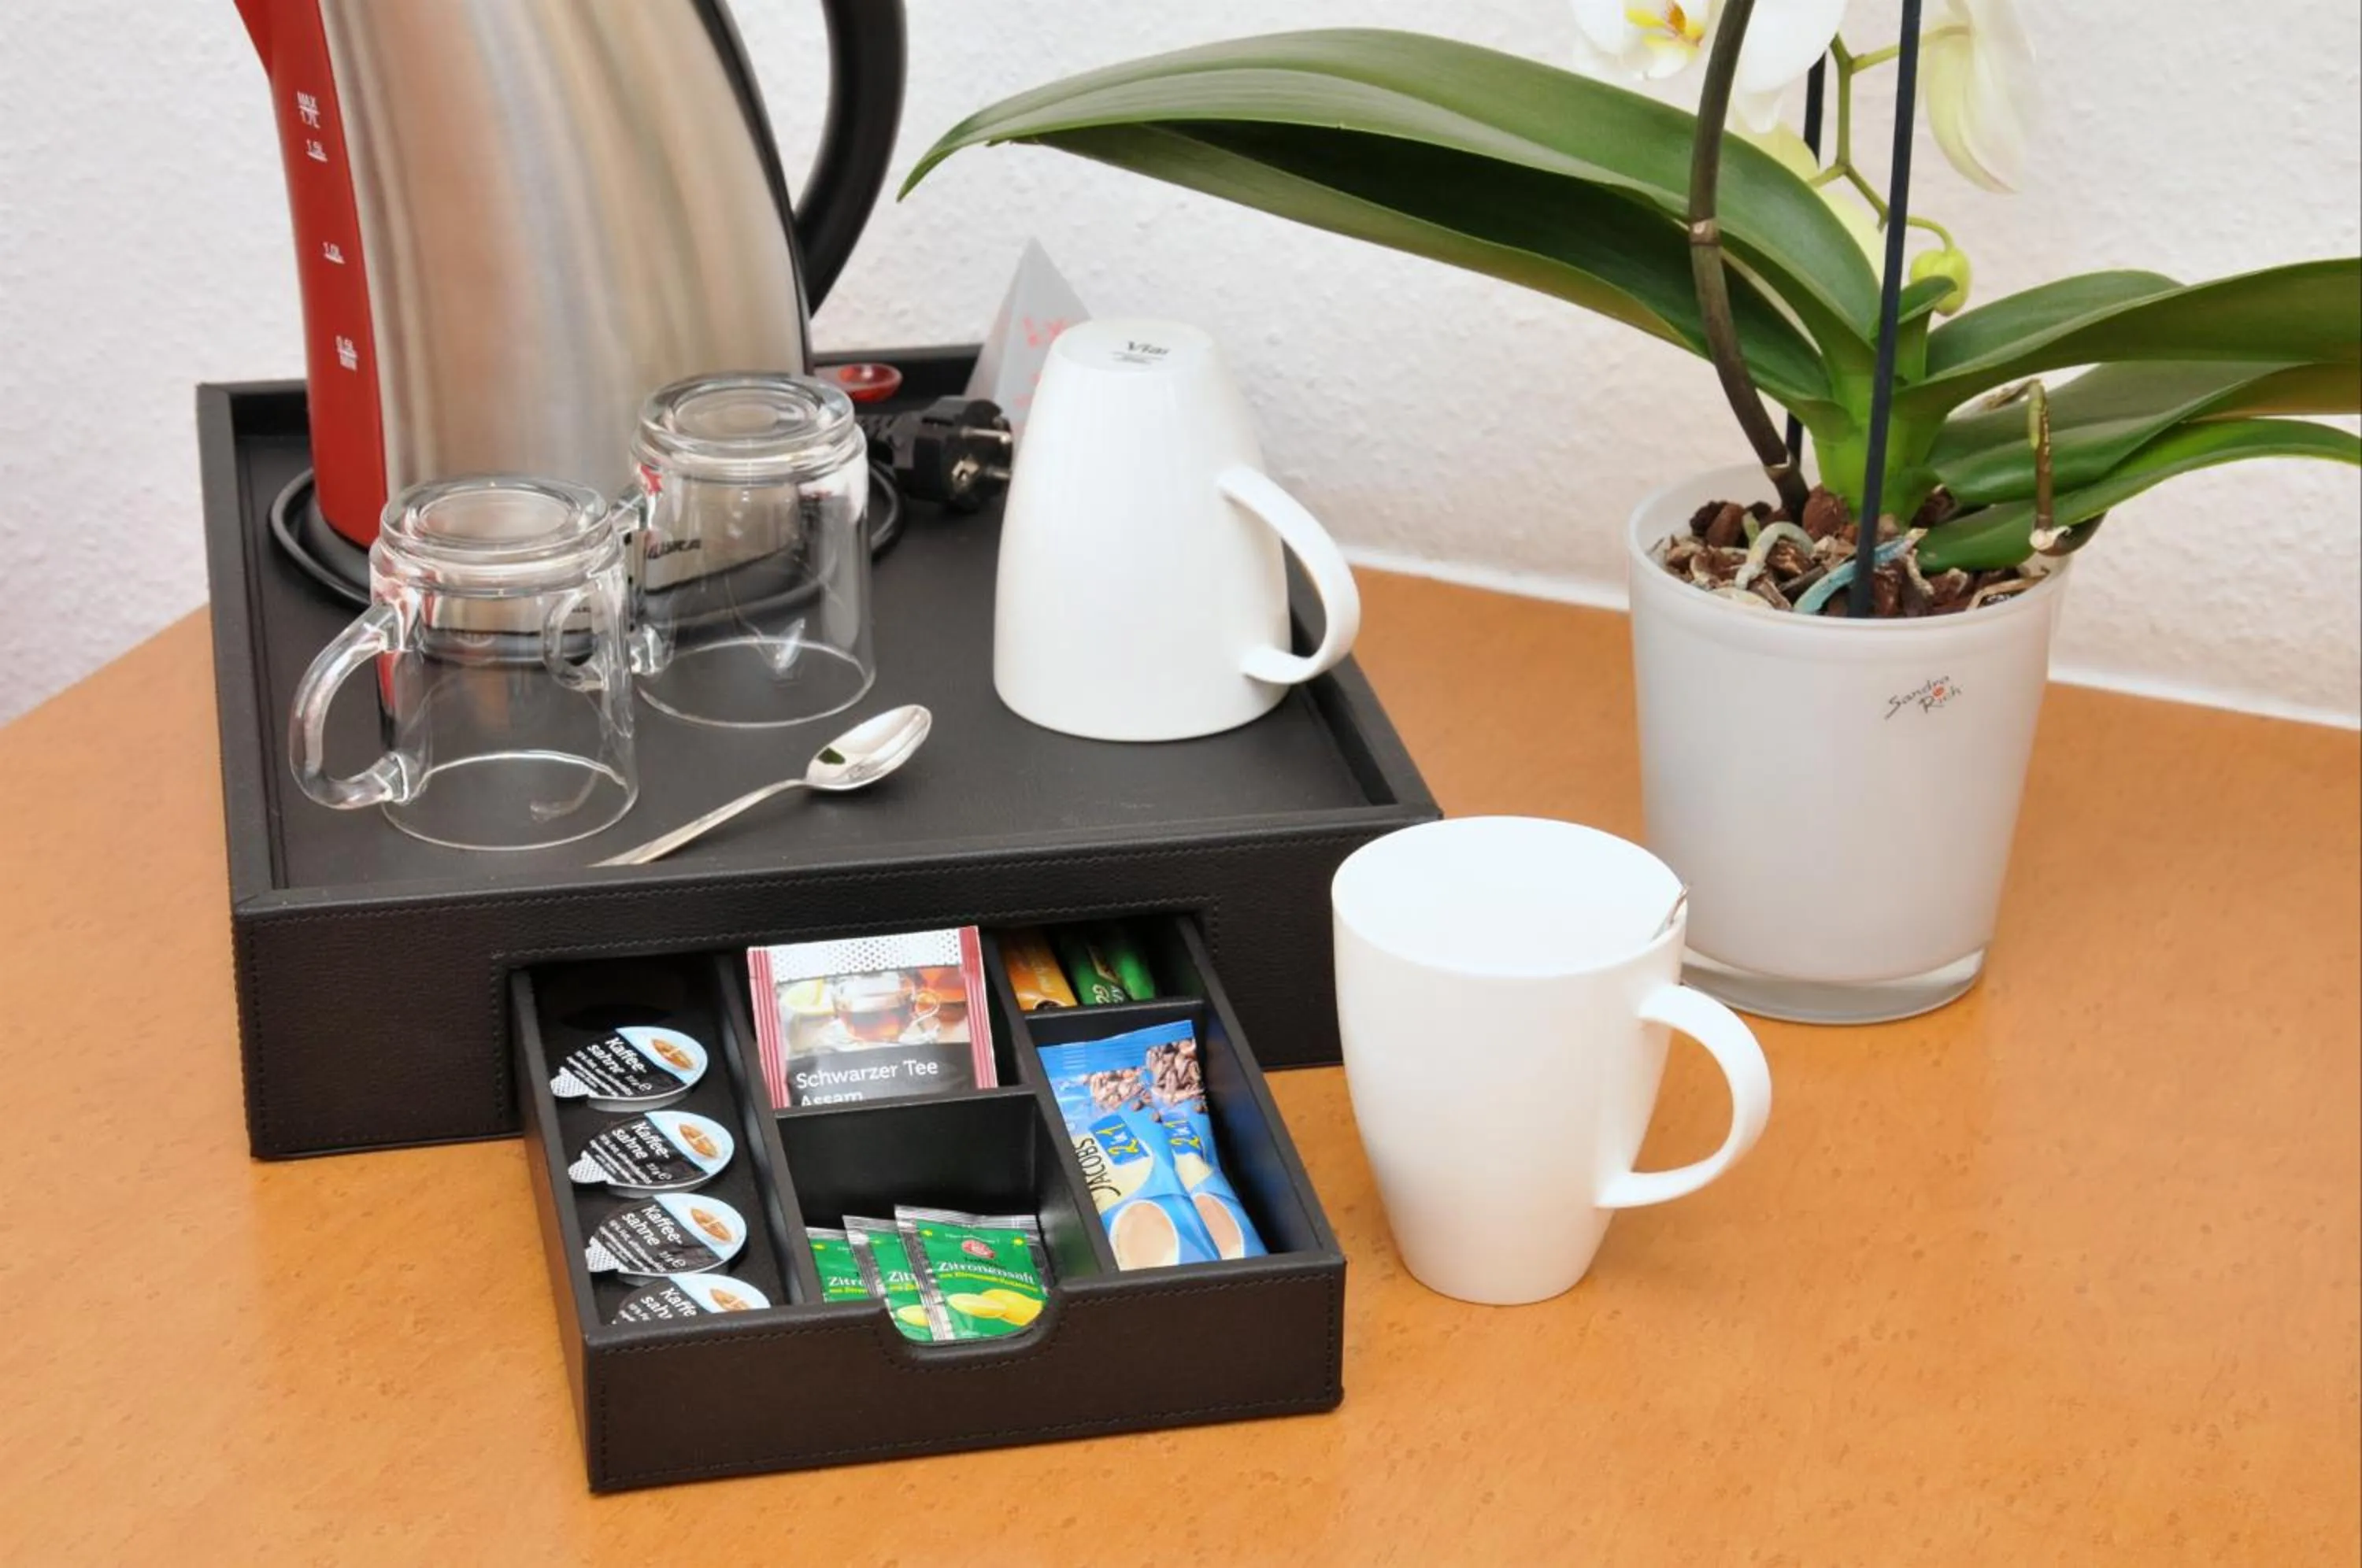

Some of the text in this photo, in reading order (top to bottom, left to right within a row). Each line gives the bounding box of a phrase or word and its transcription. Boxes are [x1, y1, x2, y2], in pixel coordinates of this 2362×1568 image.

[1884, 675, 1949, 720] Sandra
[1919, 685, 1964, 714] Rich
[587, 1044, 626, 1074] sahne
[605, 1037, 647, 1074] Kaffee-
[796, 1060, 939, 1089] Schwarzer Tee
[611, 1128, 649, 1160] sahne
[631, 1121, 670, 1159] Kaffee-
[1075, 1137, 1122, 1197] JACOBS
[622, 1212, 661, 1246] sahne
[642, 1204, 683, 1244] Kaffee-
[939, 1261, 1035, 1285] Zitronensaft
